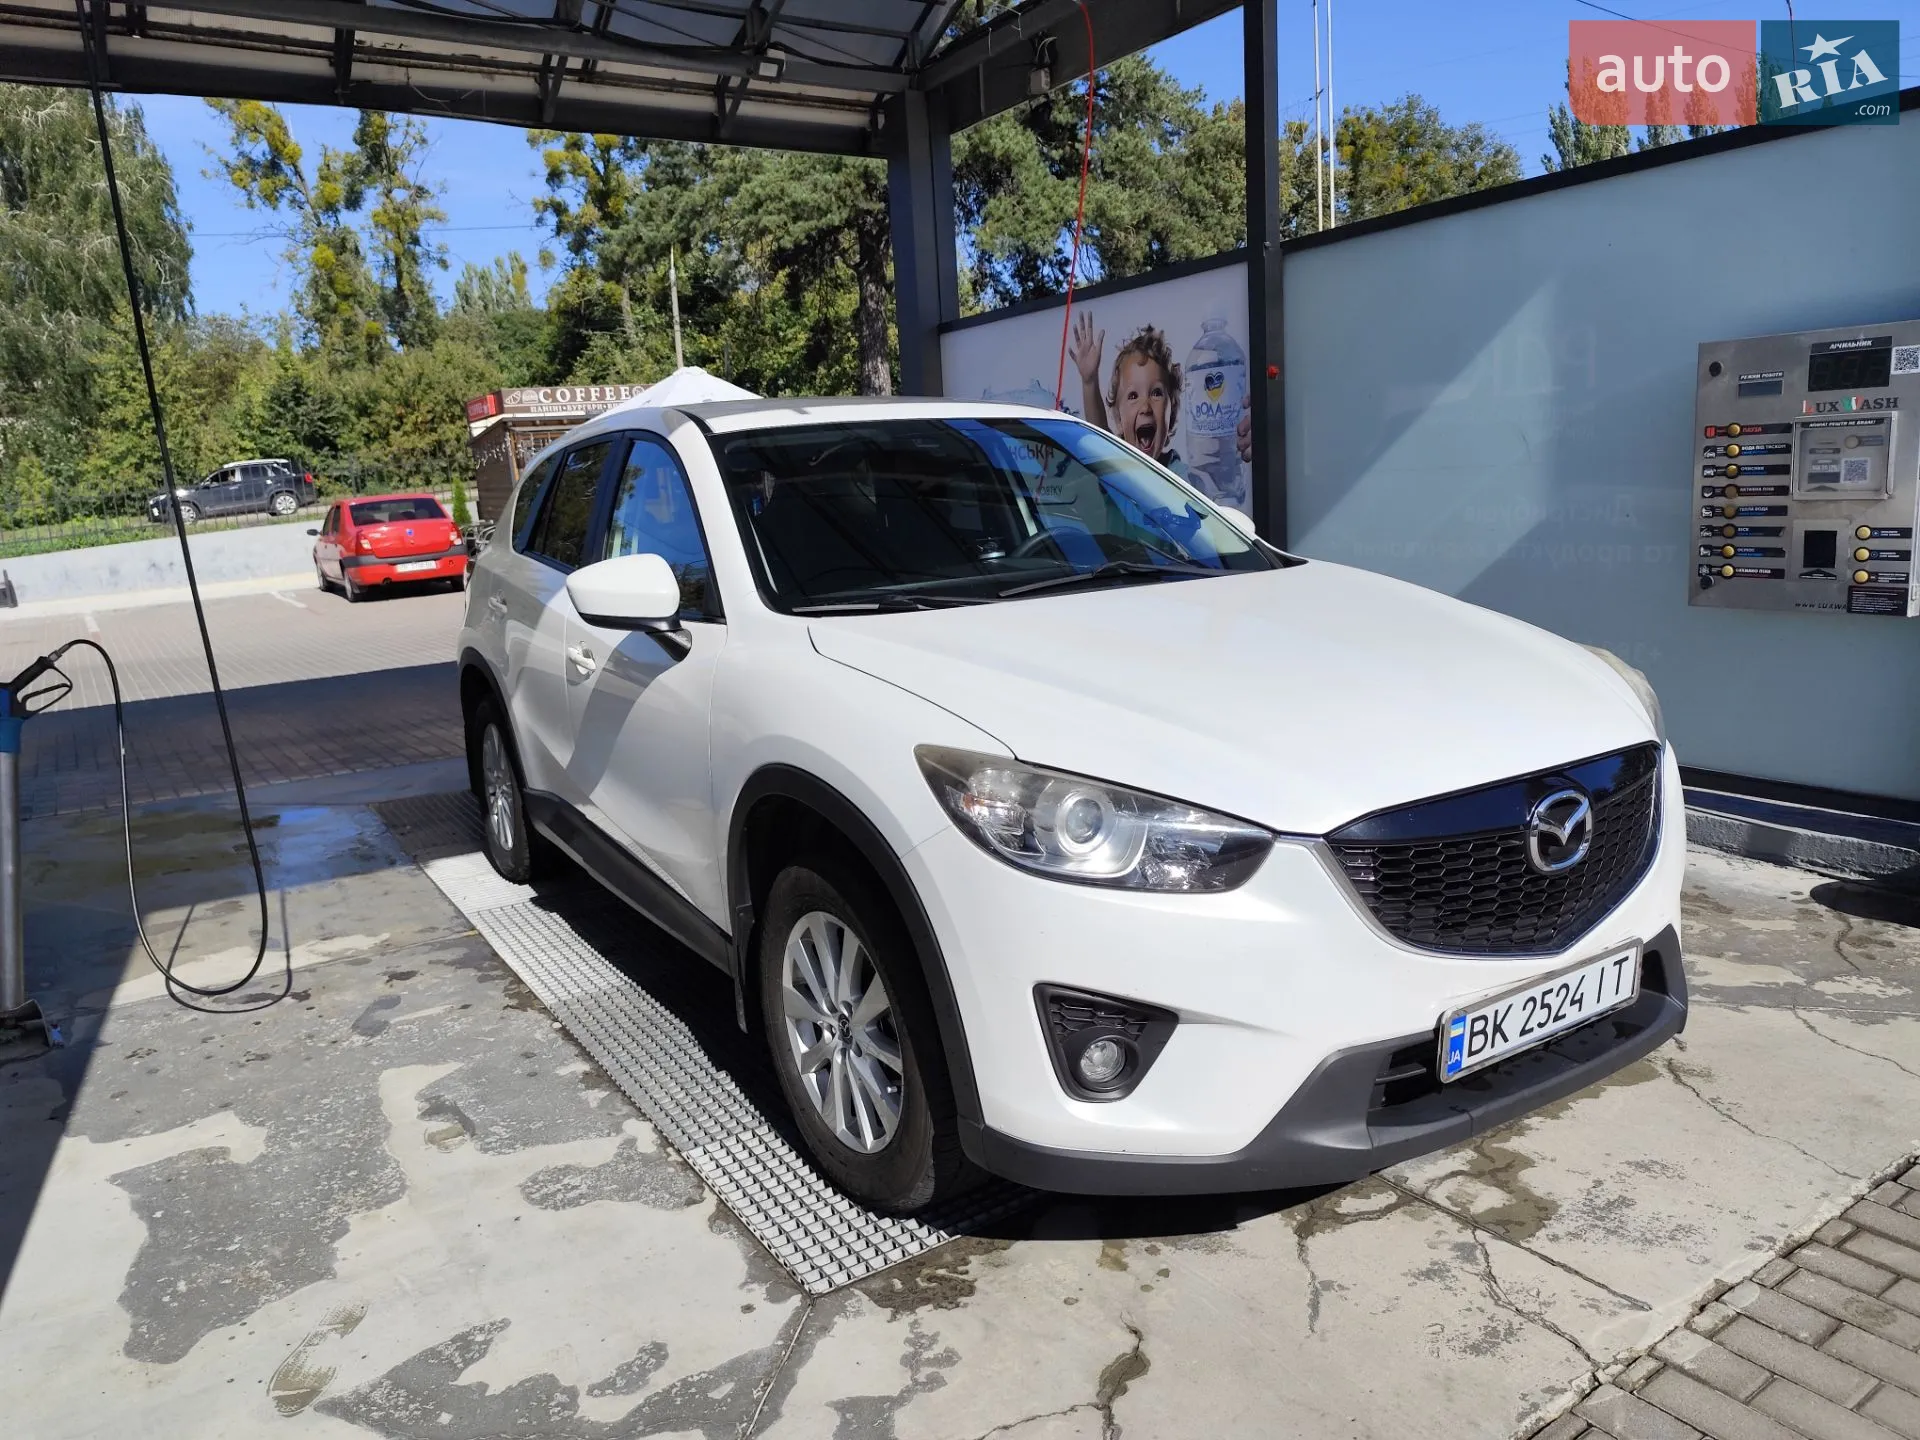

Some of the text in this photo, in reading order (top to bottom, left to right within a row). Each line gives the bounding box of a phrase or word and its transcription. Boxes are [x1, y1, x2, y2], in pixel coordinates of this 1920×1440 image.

[539, 386, 632, 404] COFFEE
[1467, 1003, 1514, 1058] BK
[1518, 974, 1587, 1037] 2524
